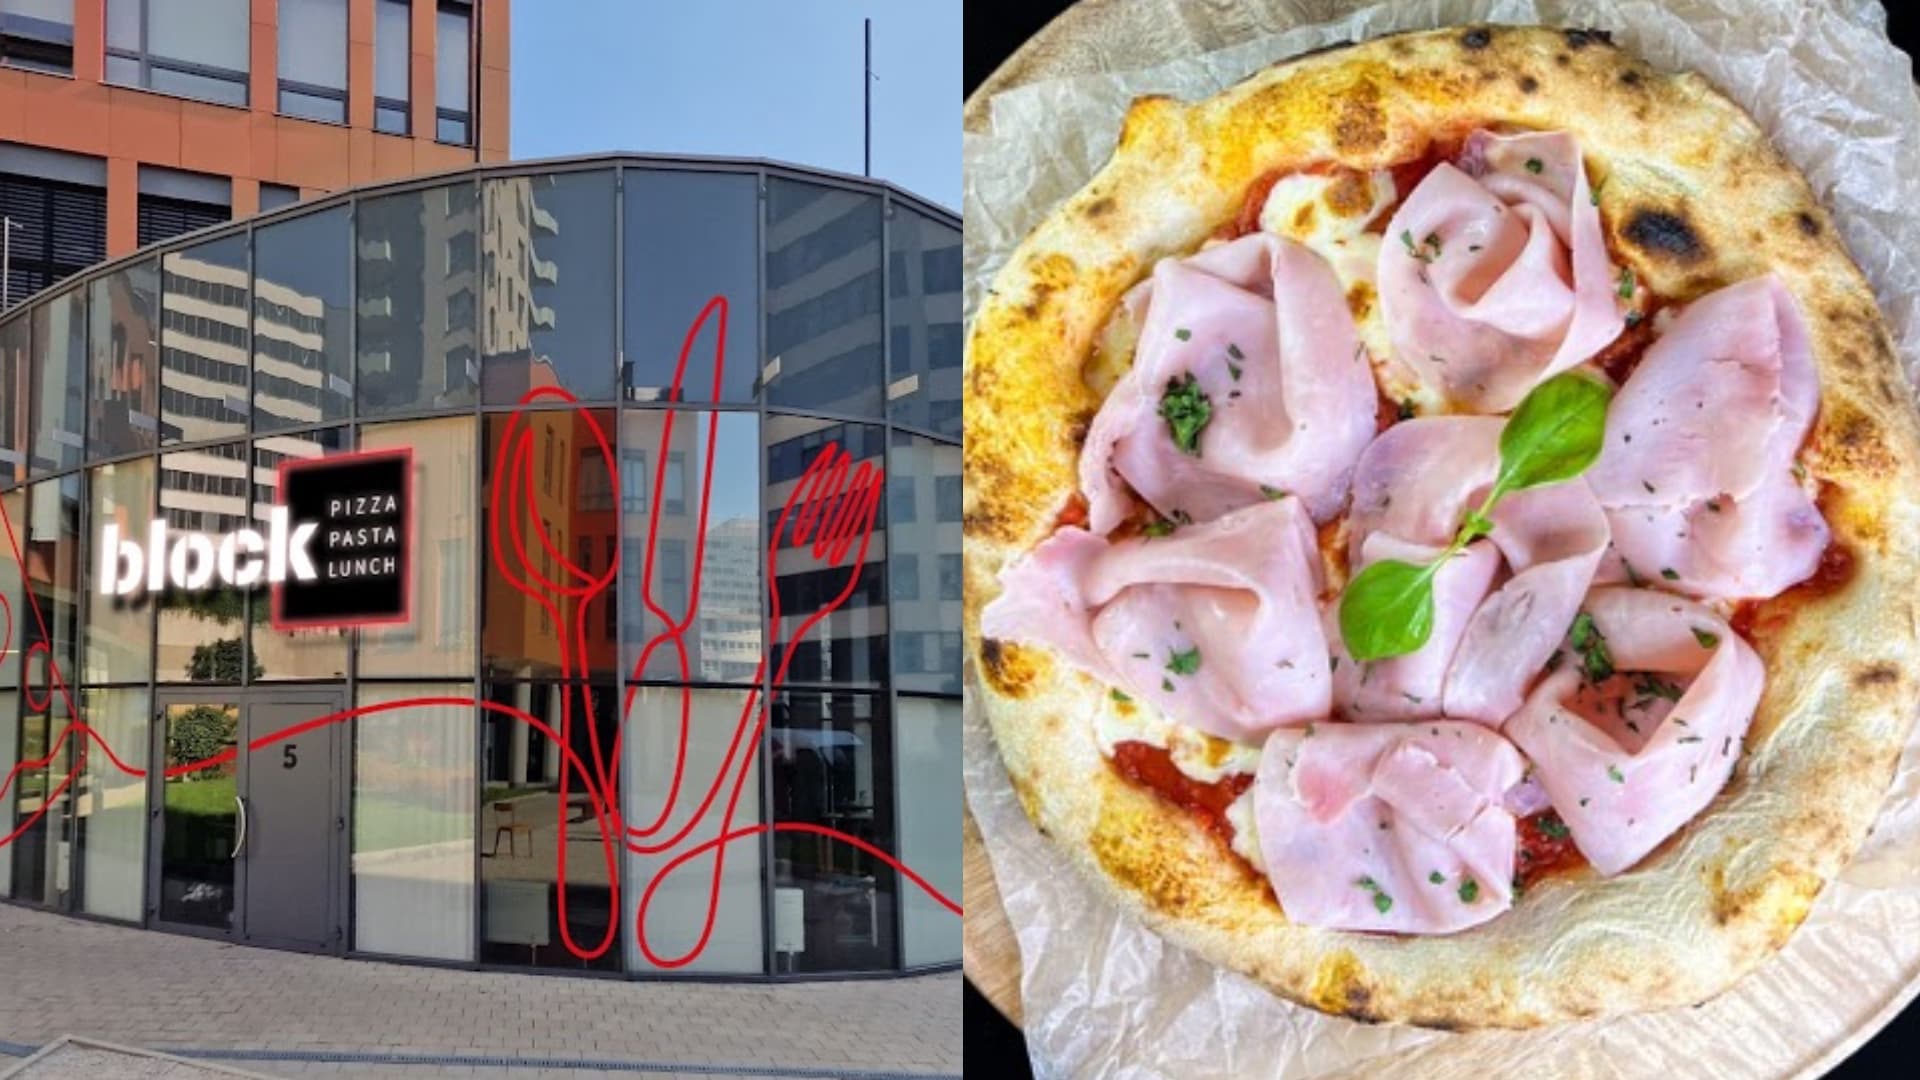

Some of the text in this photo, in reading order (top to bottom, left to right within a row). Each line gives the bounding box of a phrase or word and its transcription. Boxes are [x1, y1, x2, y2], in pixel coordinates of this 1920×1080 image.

[330, 494, 397, 518] PIZZA
[328, 526, 396, 549] PASTA
[100, 505, 319, 596] block
[328, 556, 395, 579] LUNCH
[283, 744, 298, 769] 5
